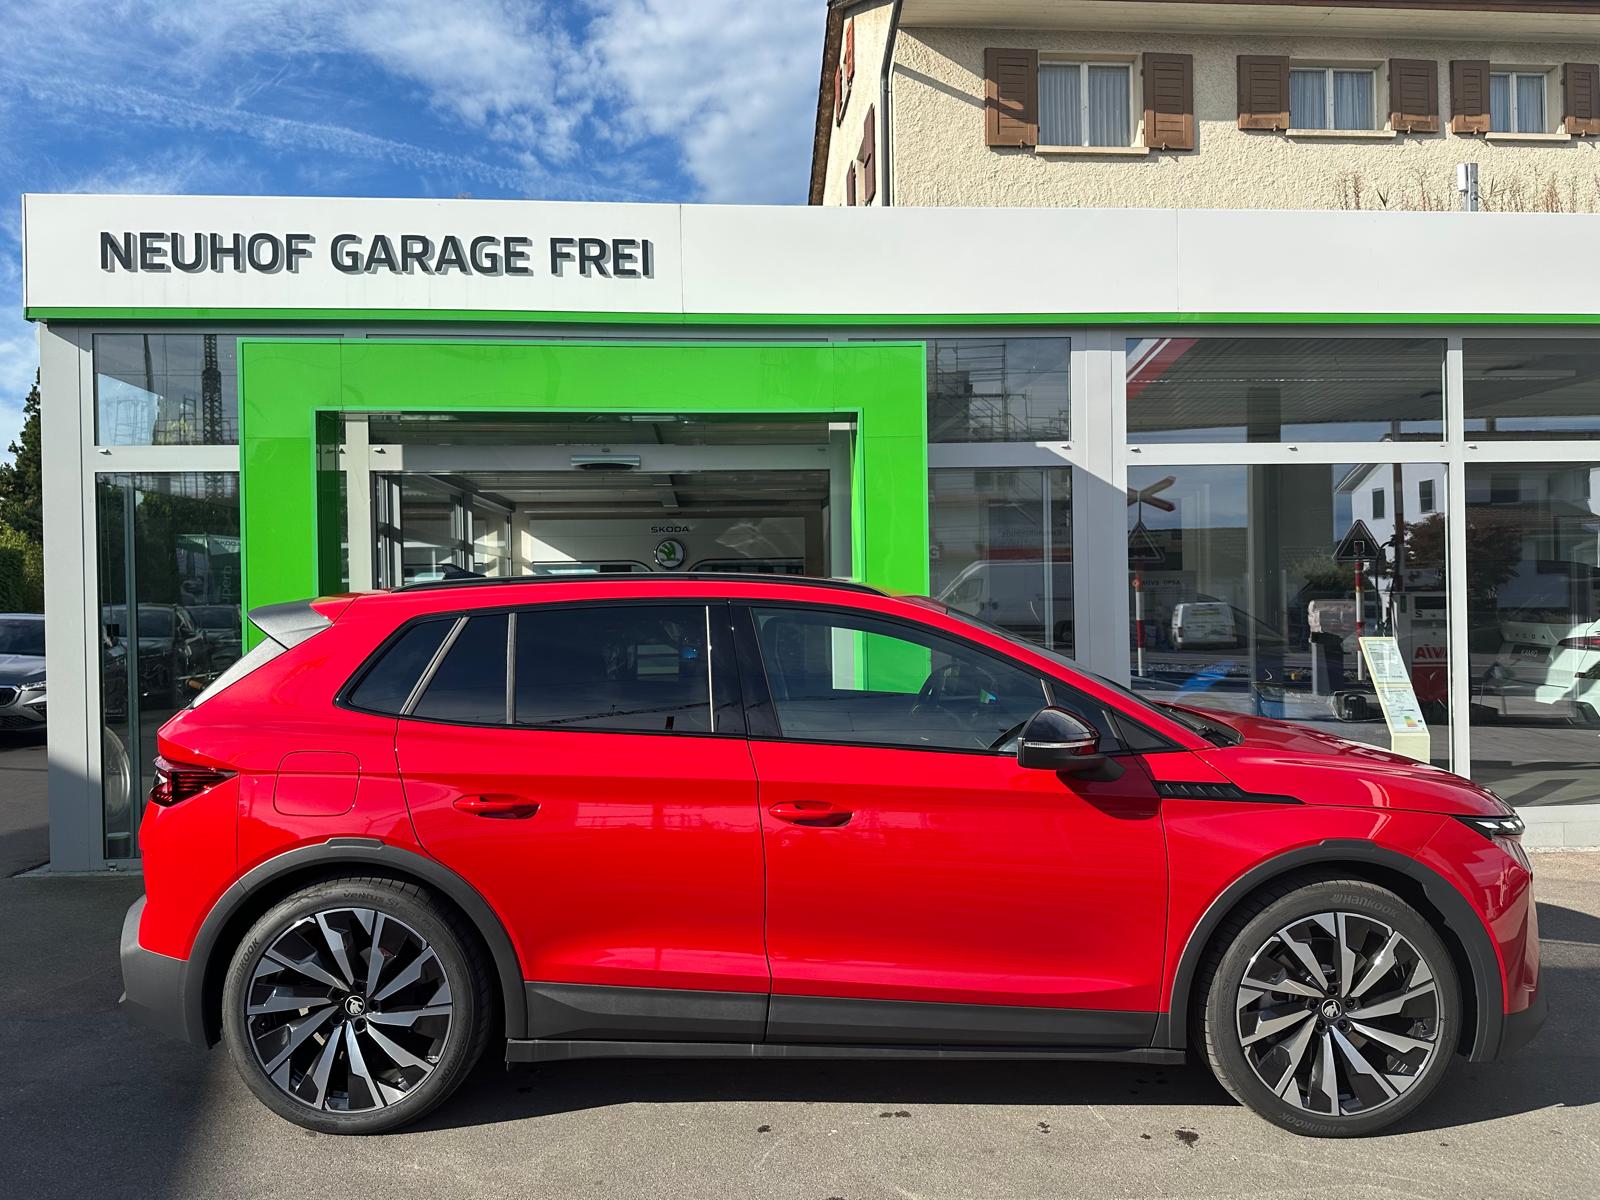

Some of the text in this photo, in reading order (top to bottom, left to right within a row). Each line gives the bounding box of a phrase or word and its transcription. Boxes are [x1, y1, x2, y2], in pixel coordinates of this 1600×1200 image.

[100, 231, 655, 279] NEUHOF GARAGE FREI
